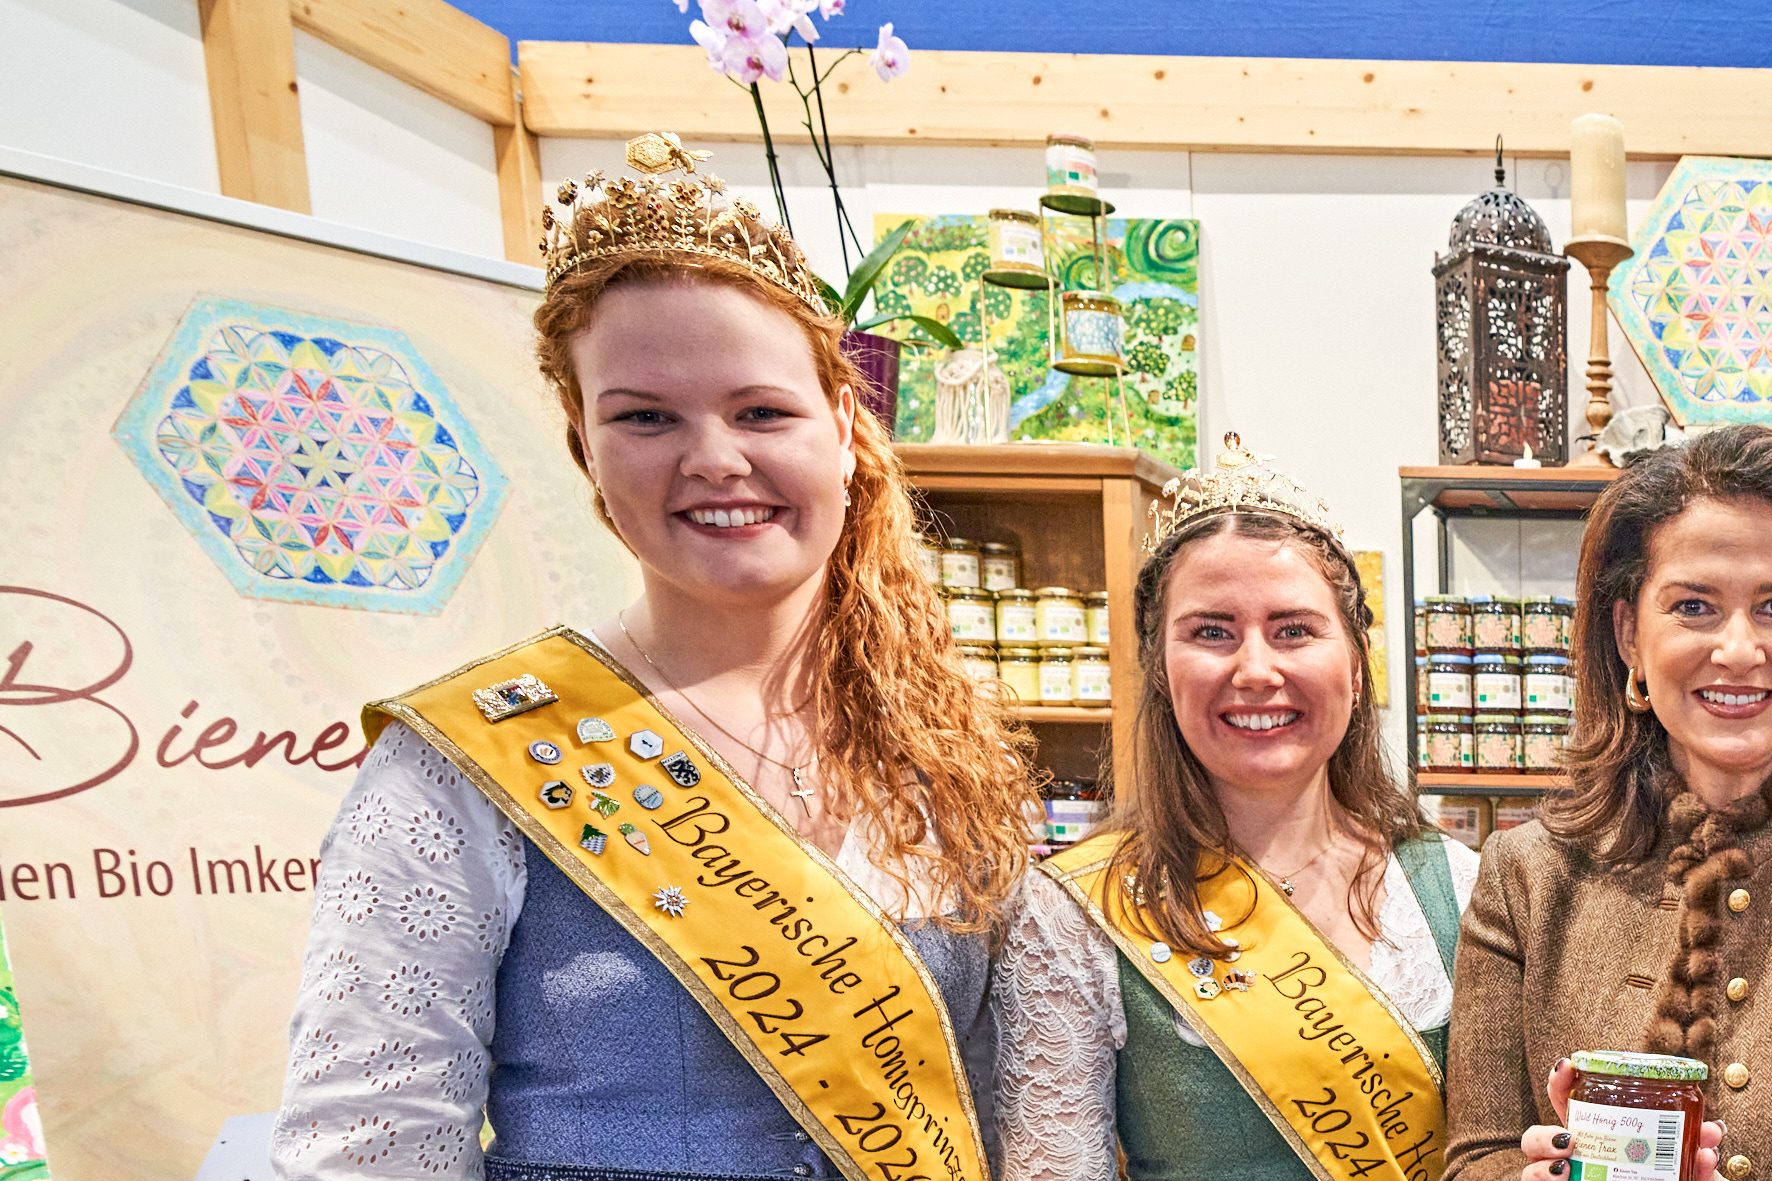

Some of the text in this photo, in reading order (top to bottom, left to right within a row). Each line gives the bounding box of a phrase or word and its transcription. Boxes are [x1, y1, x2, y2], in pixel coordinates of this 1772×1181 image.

[0, 585, 378, 808] Biene
[93, 844, 323, 898] Bio Imker
[651, 795, 862, 997] Bayerische
[701, 945, 829, 1057] 2024
[1263, 950, 1414, 1140] Bayerische
[1292, 1087, 1388, 1180] 2024
[1573, 1138, 1618, 1153] Bienen Trax
[1574, 1110, 1644, 1133] Wald Honig 500g
